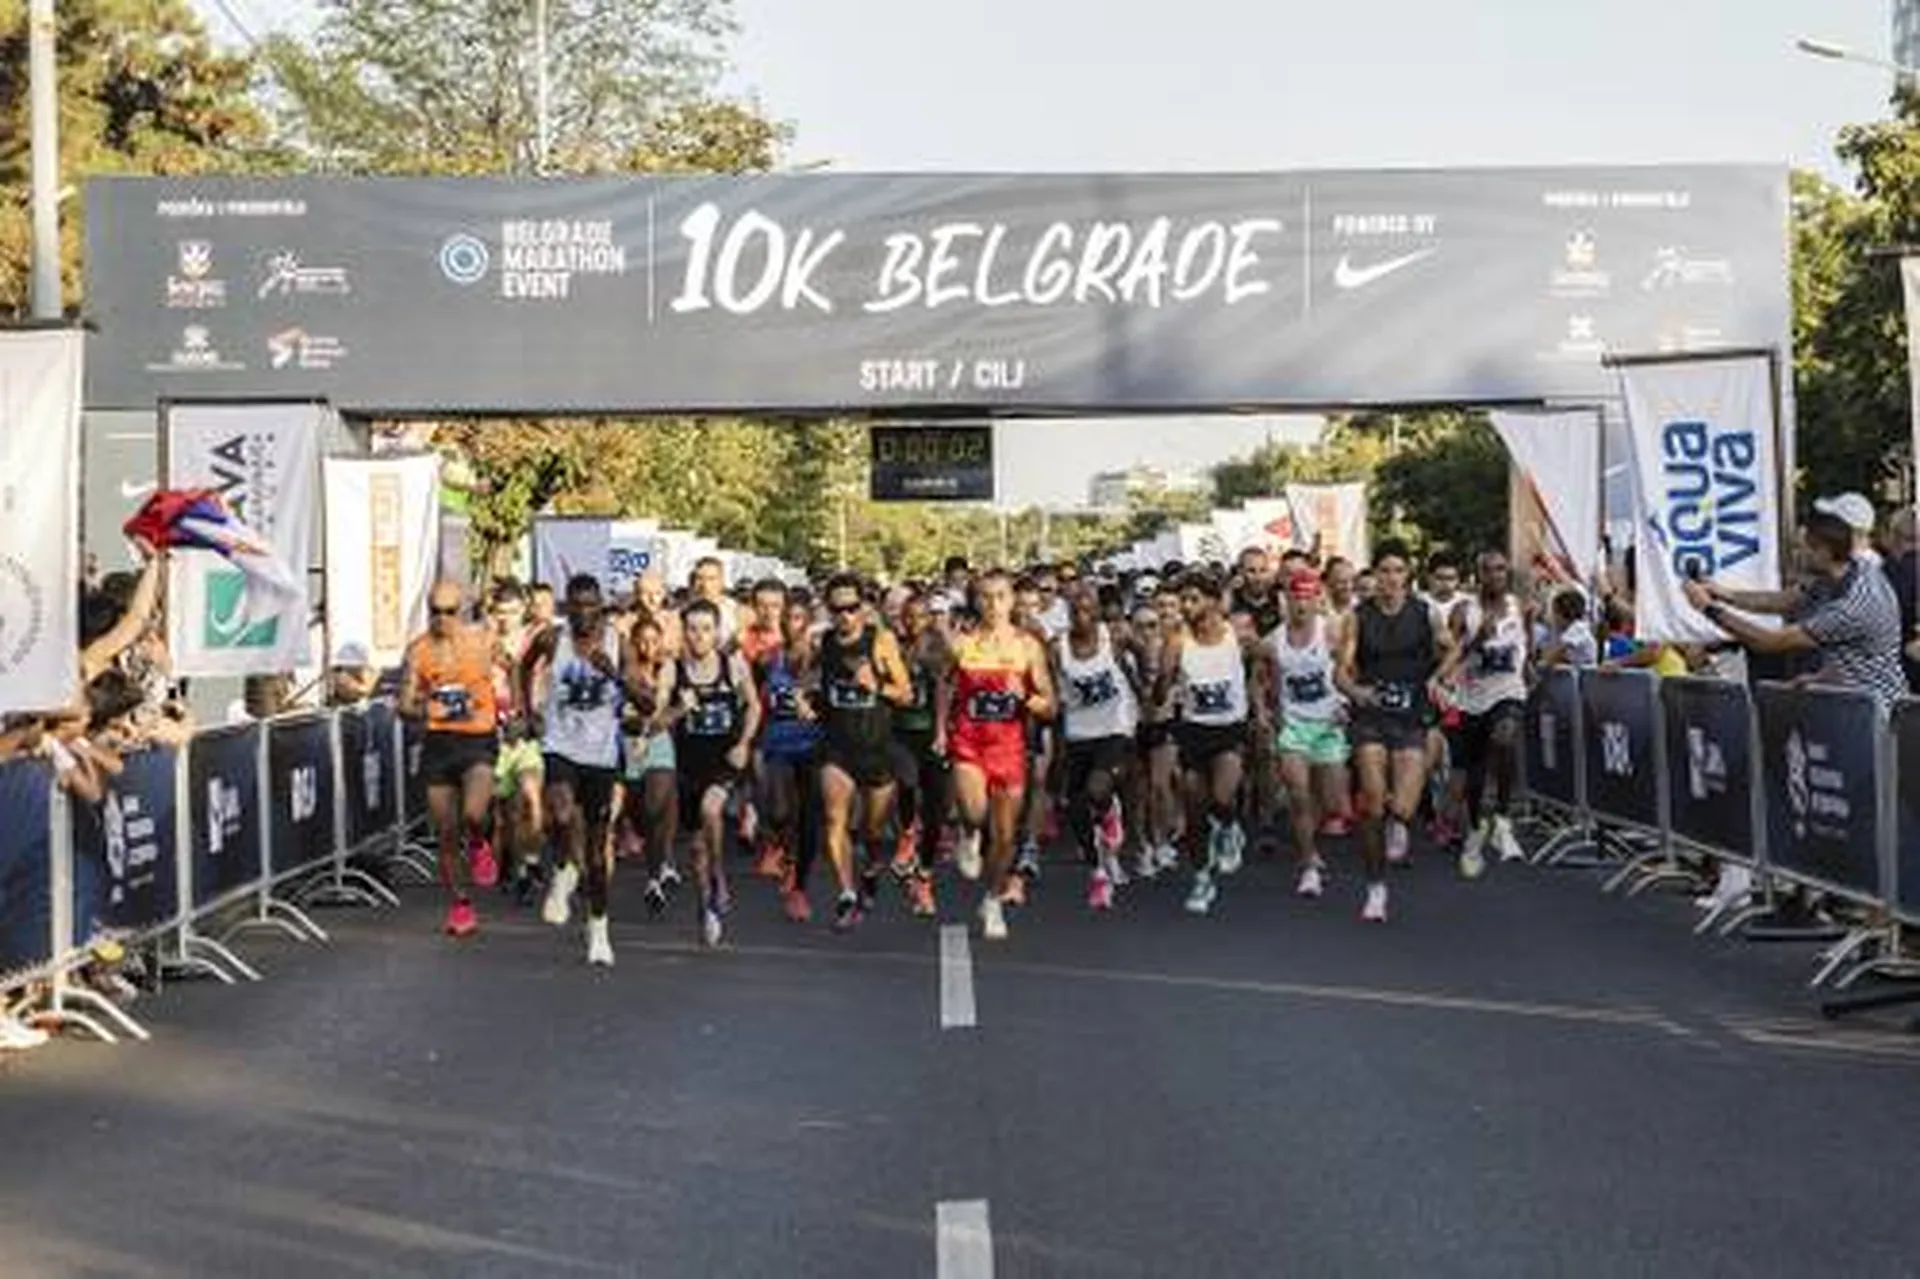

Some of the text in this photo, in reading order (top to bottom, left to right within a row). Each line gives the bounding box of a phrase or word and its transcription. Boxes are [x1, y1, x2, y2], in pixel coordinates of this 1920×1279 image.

[503, 246, 625, 272] MARATHON
[671, 203, 1283, 313] 10K BELGRADE
[503, 272, 570, 298] EVENT
[859, 361, 938, 391] START
[974, 361, 1024, 390] CILJ
[1714, 432, 1759, 569] viva
